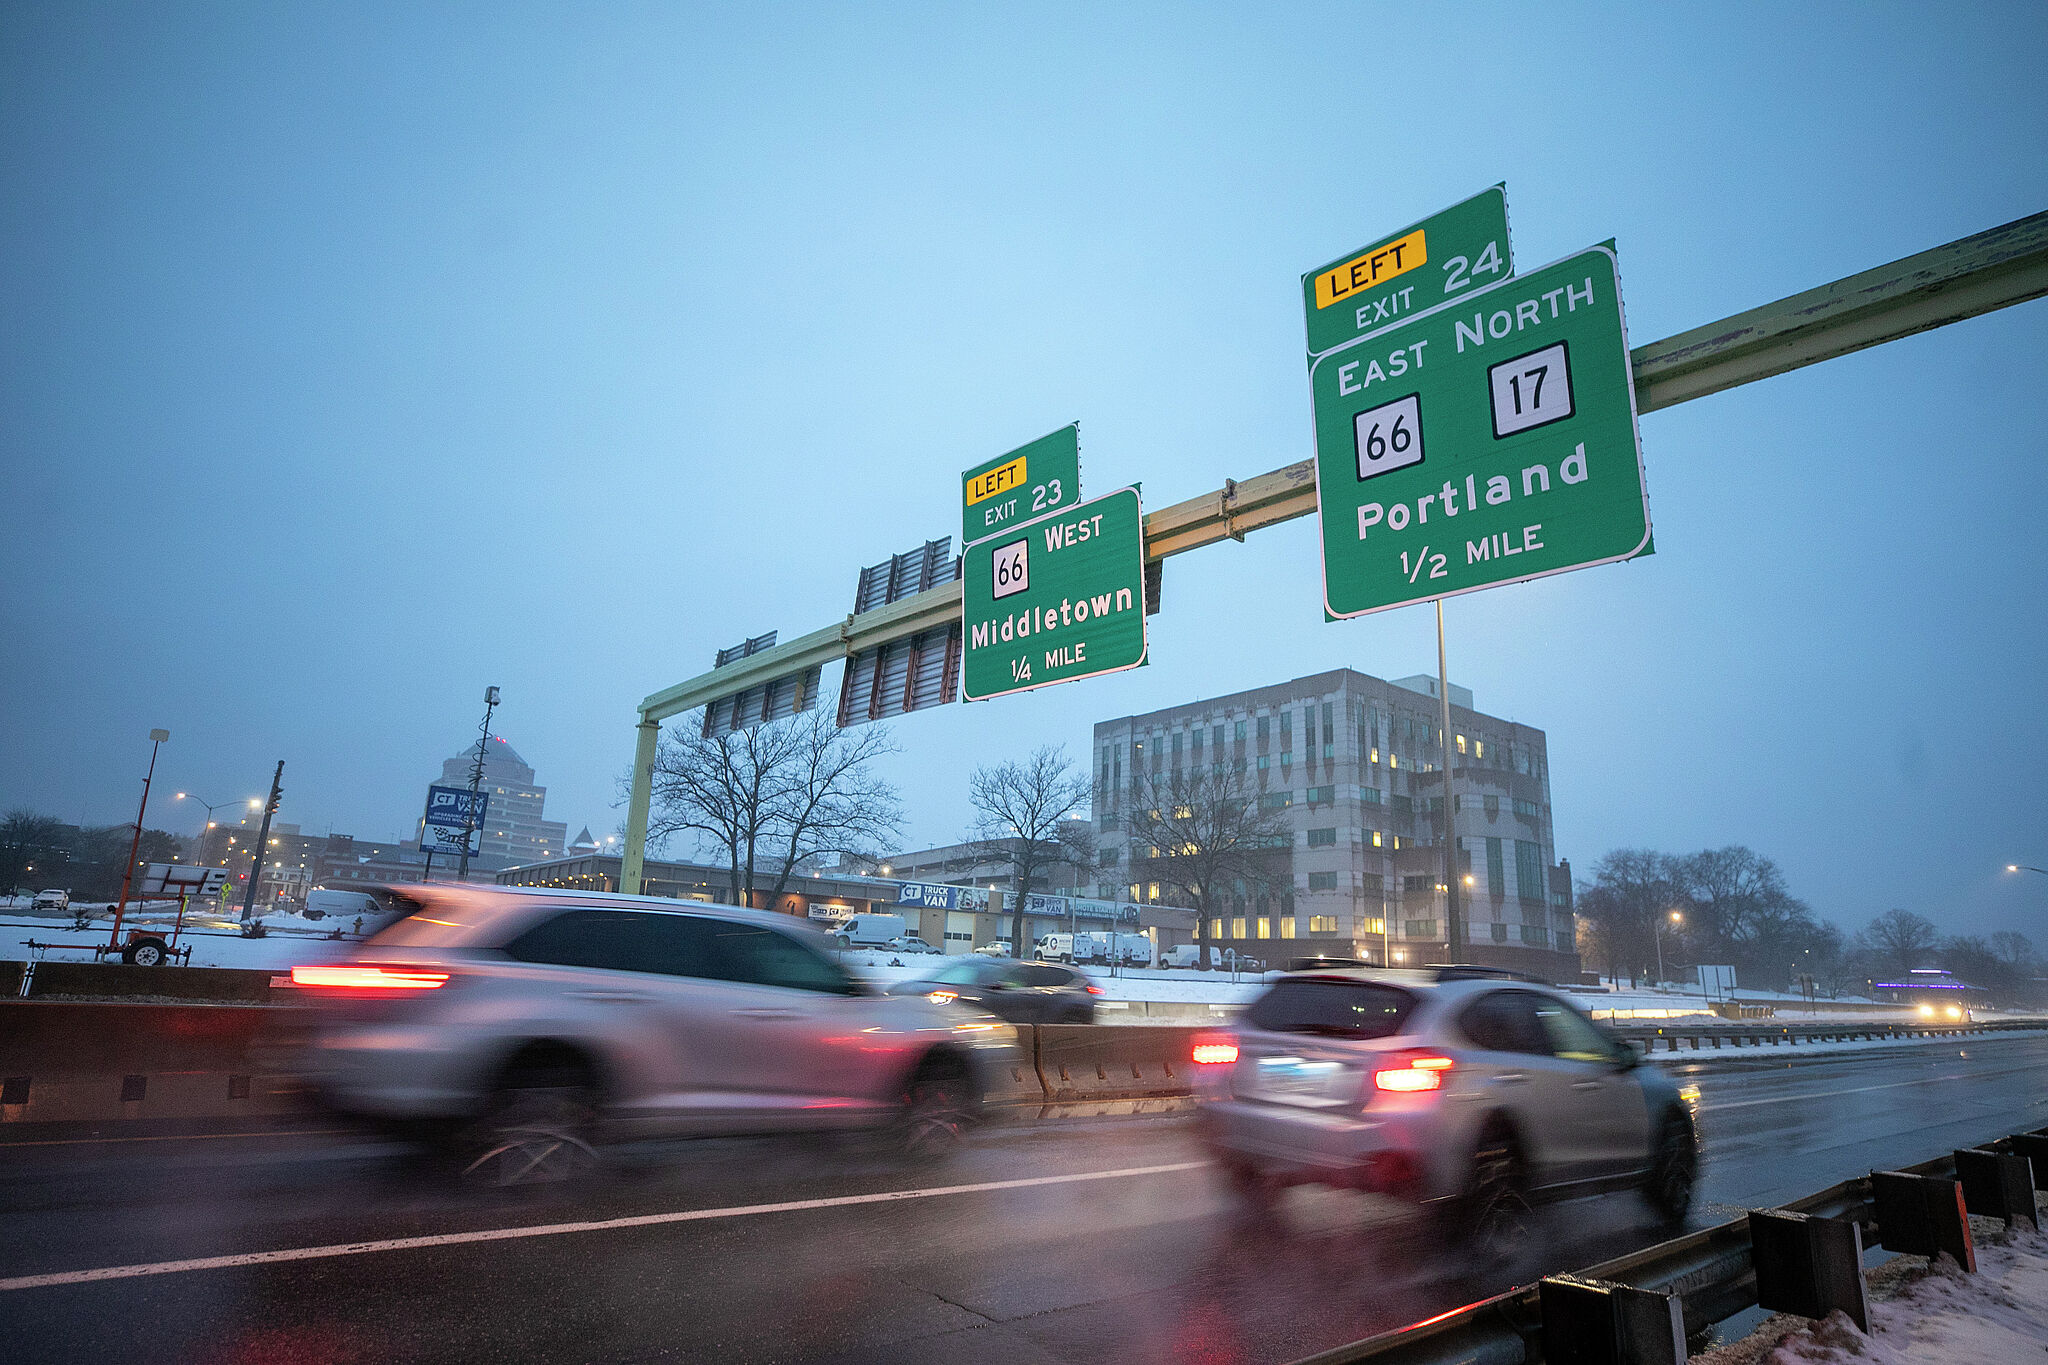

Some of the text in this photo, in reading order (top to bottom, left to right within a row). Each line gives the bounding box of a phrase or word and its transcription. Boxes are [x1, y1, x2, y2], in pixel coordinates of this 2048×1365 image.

[1331, 243, 1408, 298] LEFT
[1356, 240, 1503, 329] EXIT 24
[1338, 277, 1595, 397] EAST NORTH
[1508, 365, 1549, 415] 17
[1366, 414, 1411, 461] 66
[975, 465, 1017, 498] LEFT
[1357, 442, 1589, 540] Portland
[985, 479, 1063, 527] EXIT 23
[1044, 514, 1103, 552] WEST
[1466, 523, 1544, 565] MILE
[998, 553, 1023, 586] 66
[971, 587, 1132, 650] Middletown
[1045, 642, 1086, 670] MILE
[438, 795, 451, 804] CT
[905, 887, 917, 897] CT
[924, 886, 948, 895] TRUCK
[924, 896, 948, 907] VAN
[1046, 904, 1062, 913] VAN
